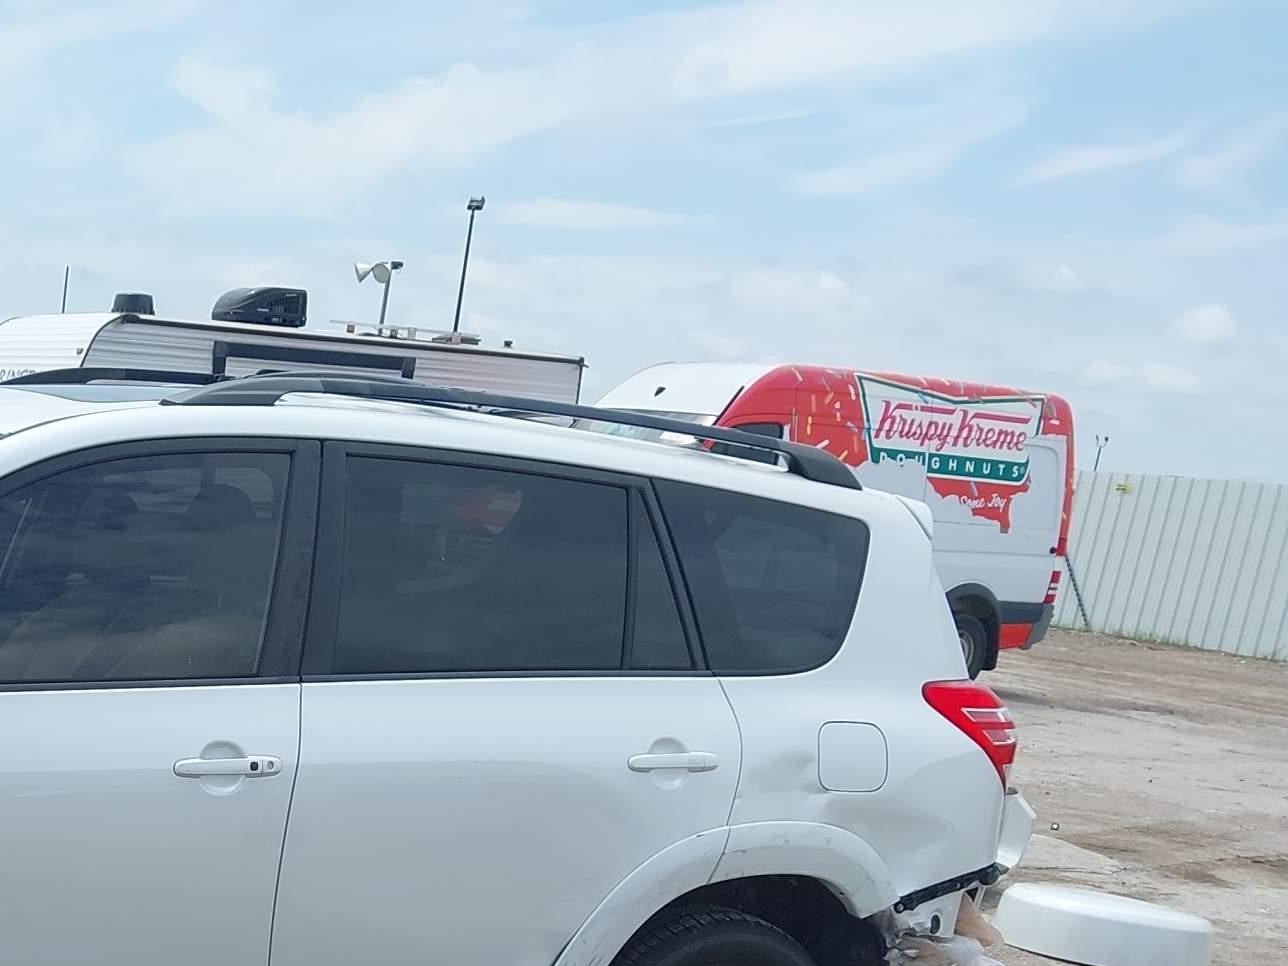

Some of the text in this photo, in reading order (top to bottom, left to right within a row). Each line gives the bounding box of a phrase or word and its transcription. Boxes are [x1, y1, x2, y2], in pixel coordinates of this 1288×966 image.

[874, 399, 1032, 452] Krispy Kreme
[879, 451, 1019, 478] DOUGHNUTS
[986, 493, 1007, 513] Joy
